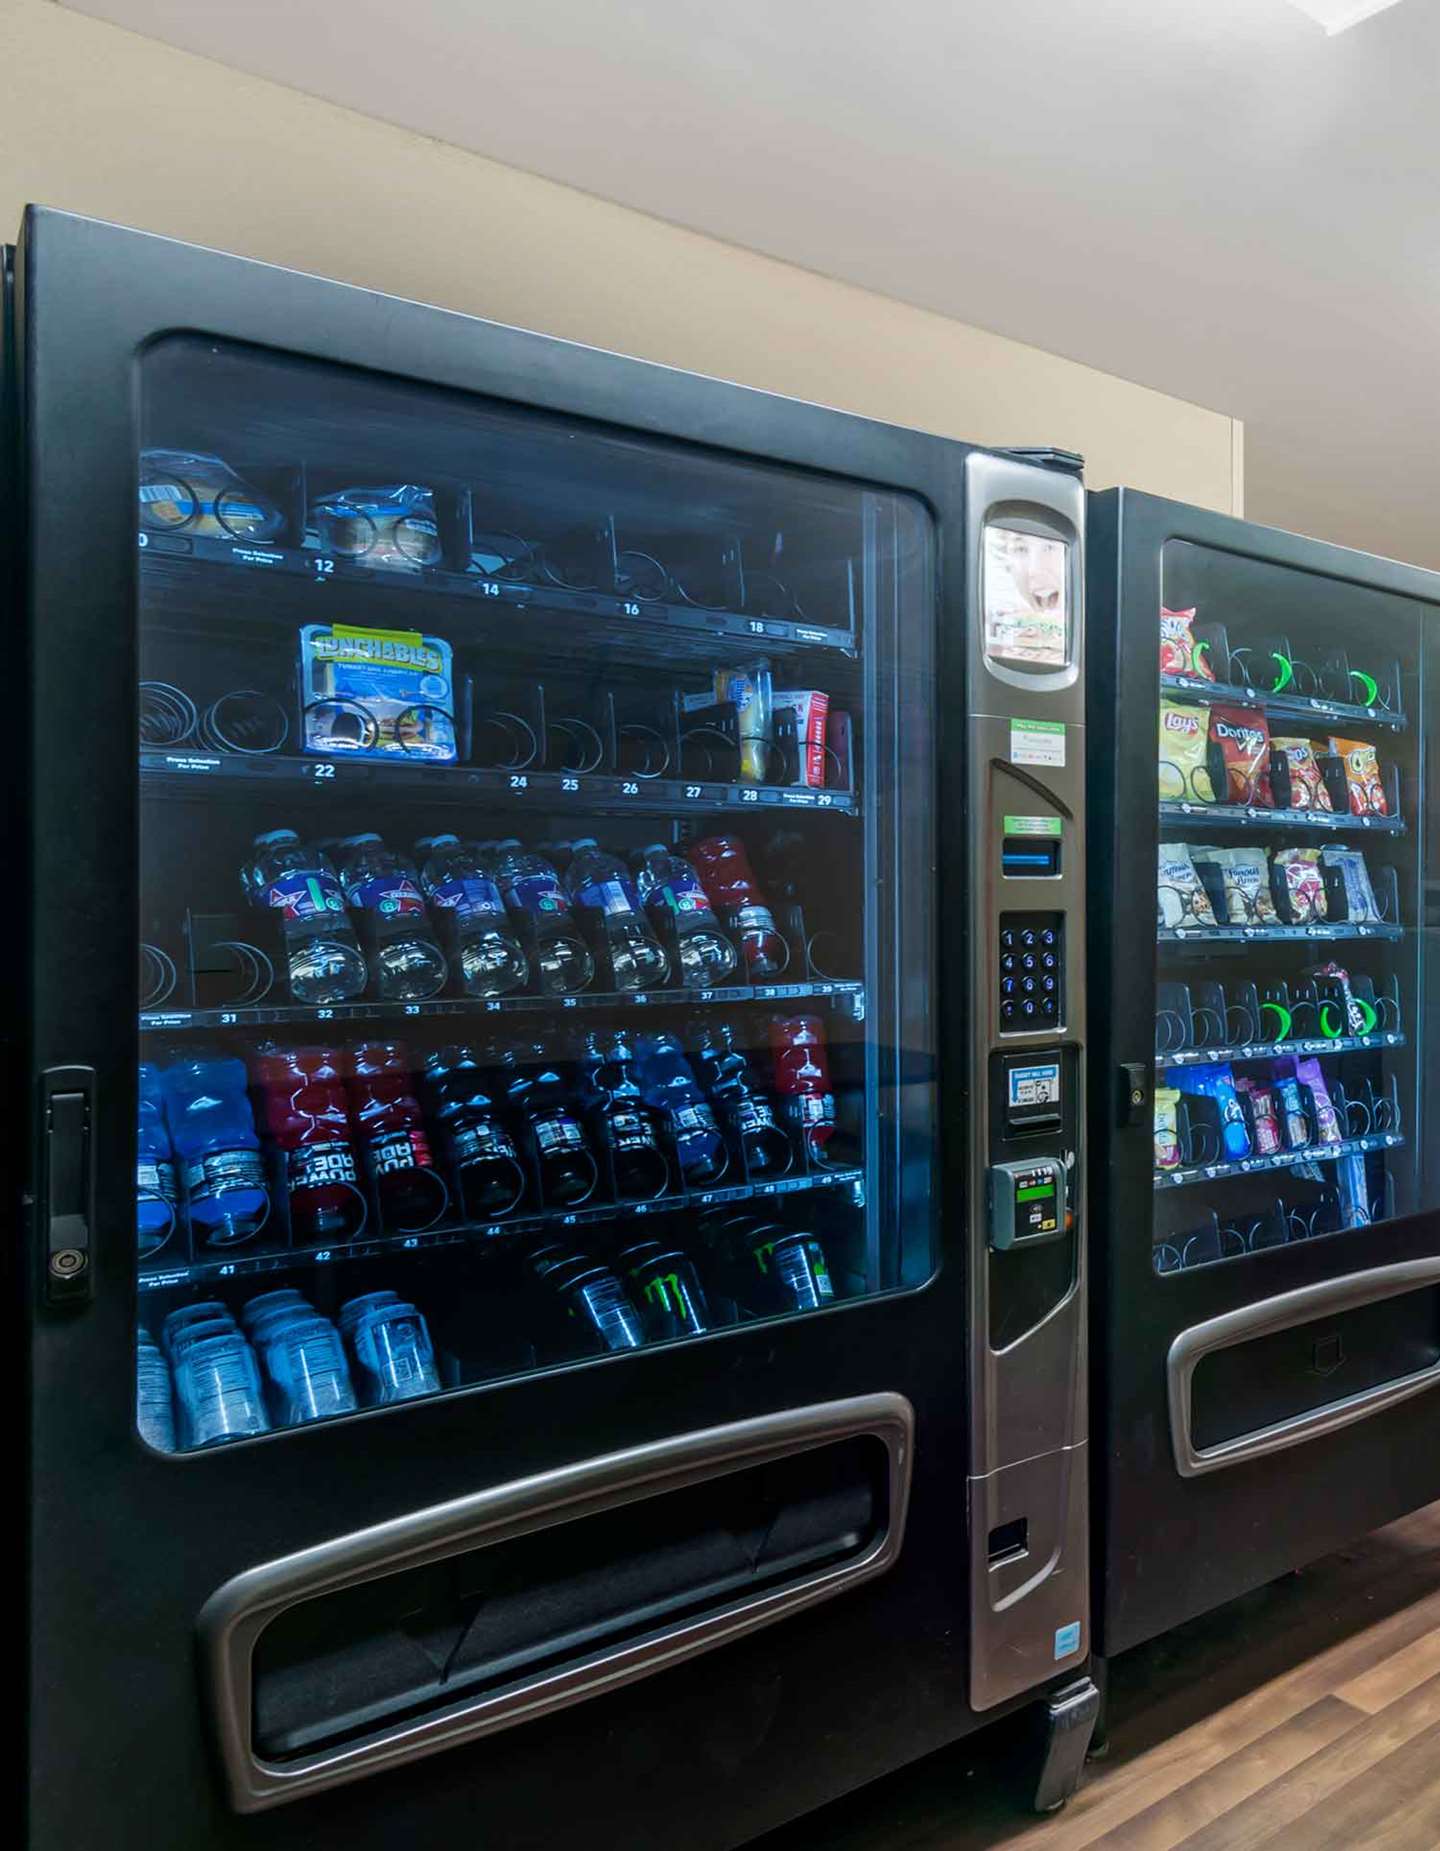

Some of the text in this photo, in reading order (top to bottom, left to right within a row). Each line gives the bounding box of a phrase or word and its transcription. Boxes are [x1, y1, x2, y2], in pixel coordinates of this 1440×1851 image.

[314, 559, 335, 573] 12
[482, 583, 499, 596] 14
[624, 603, 640, 616] 16
[749, 621, 764, 633] 18
[314, 637, 440, 671] LUNCHABLES
[1216, 723, 1264, 742] Doritos
[314, 763, 336, 778] 22
[510, 775, 528, 788] 24
[562, 779, 579, 791] 25
[622, 782, 639, 794] 26
[686, 786, 701, 798] 27
[743, 790, 758, 801] 28
[817, 795, 832, 806] 29
[1006, 933, 1012, 945] 1
[1026, 933, 1033, 944] 2
[1046, 931, 1053, 944] 3
[1005, 956, 1013, 968] 4
[1026, 955, 1033, 967] 5
[1046, 955, 1053, 967] 6
[1006, 979, 1013, 992] 7
[1026, 979, 1033, 991] 8
[1046, 978, 1053, 990] 9
[701, 992, 713, 1000] 37
[486, 1002, 500, 1011] 34
[563, 998, 577, 1007] 35
[1026, 1001, 1033, 1013] 0
[317, 1009, 333, 1019] 32
[405, 1005, 420, 1015] 33
[220, 1013, 237, 1023] 31
[702, 1195, 713, 1203] 47
[634, 1205, 647, 1213] 46
[563, 1215, 576, 1224] 45
[487, 1227, 500, 1235] 44
[403, 1238, 418, 1248] 43
[315, 1251, 331, 1261] 42
[219, 1265, 235, 1275] 41
